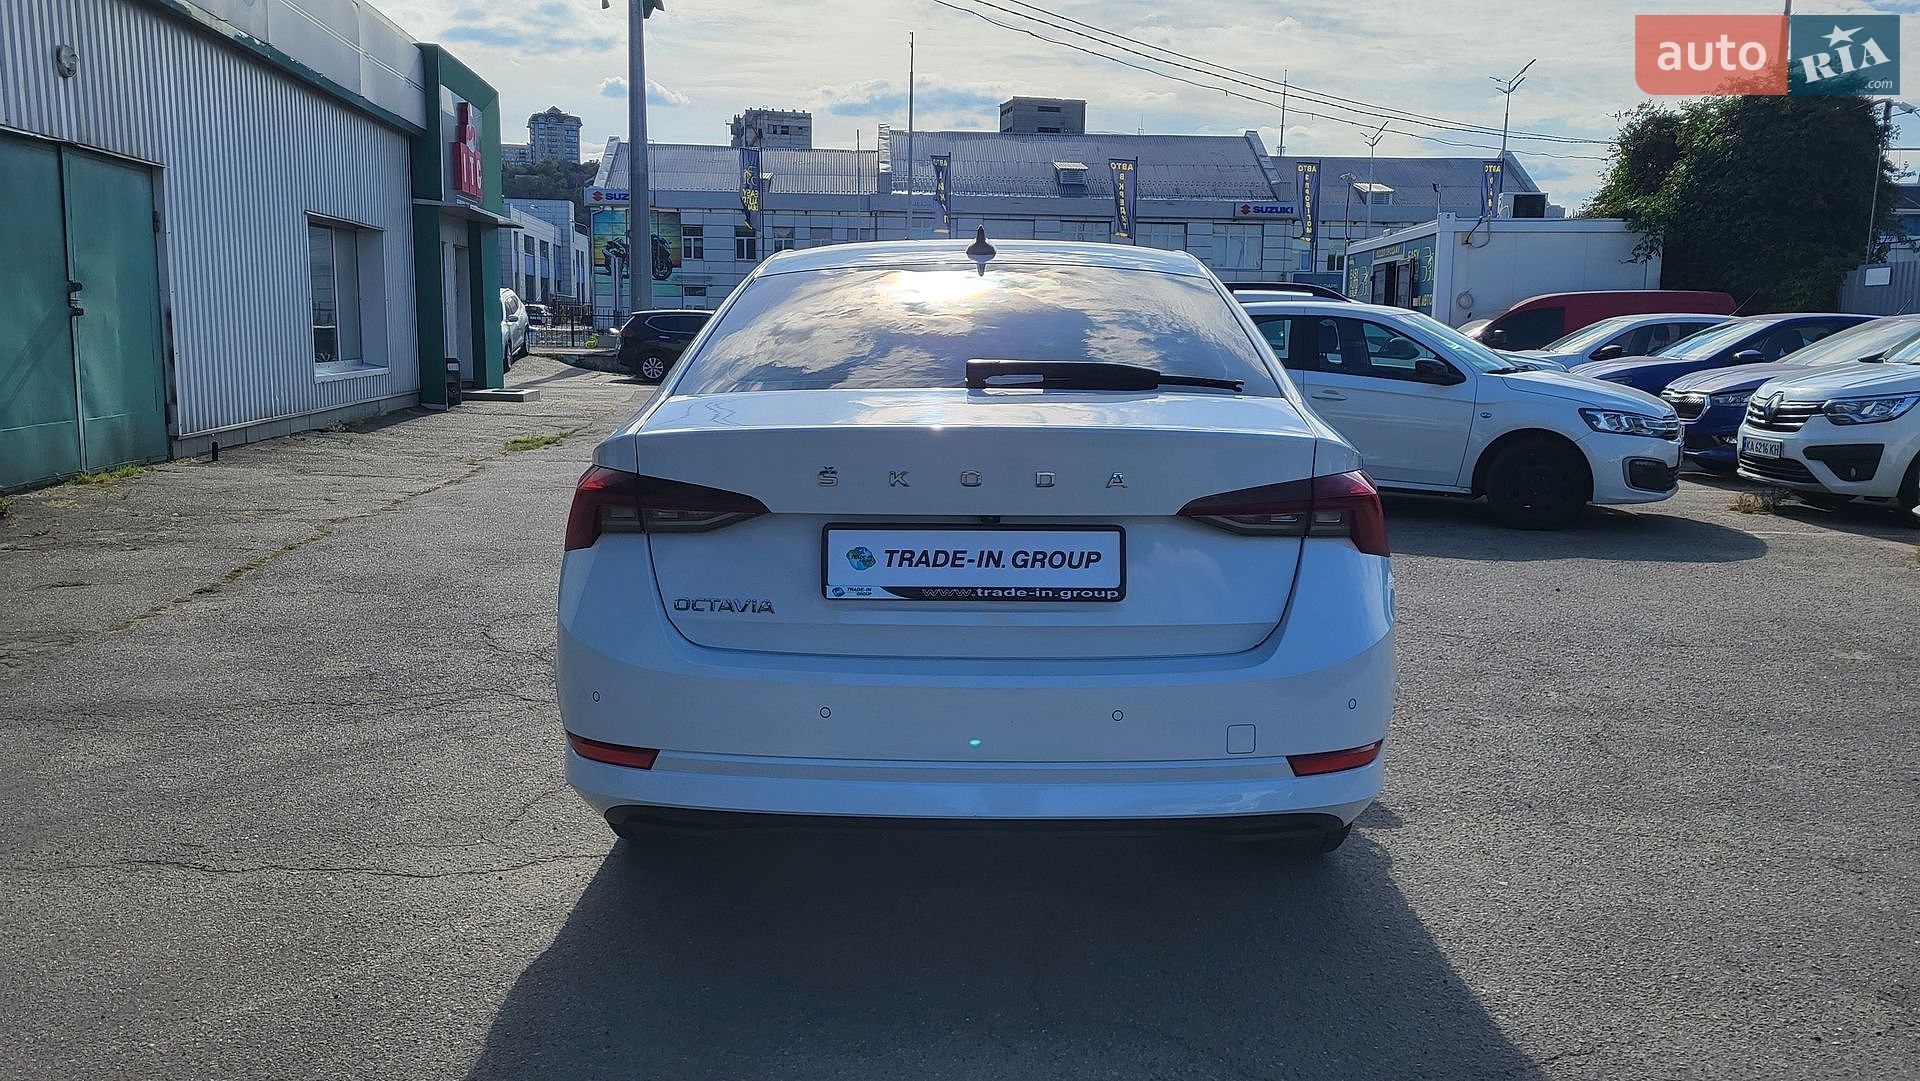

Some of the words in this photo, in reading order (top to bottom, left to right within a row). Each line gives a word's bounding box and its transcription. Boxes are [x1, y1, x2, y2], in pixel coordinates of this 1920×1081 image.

[605, 193, 630, 201] SUZ
[1253, 206, 1294, 214] SUZUKI
[817, 466, 1128, 488] ŠKODA
[1011, 550, 1102, 569] GROUP
[922, 588, 1119, 600] www.trade-in.group
[674, 598, 775, 614] OCTAVIA
